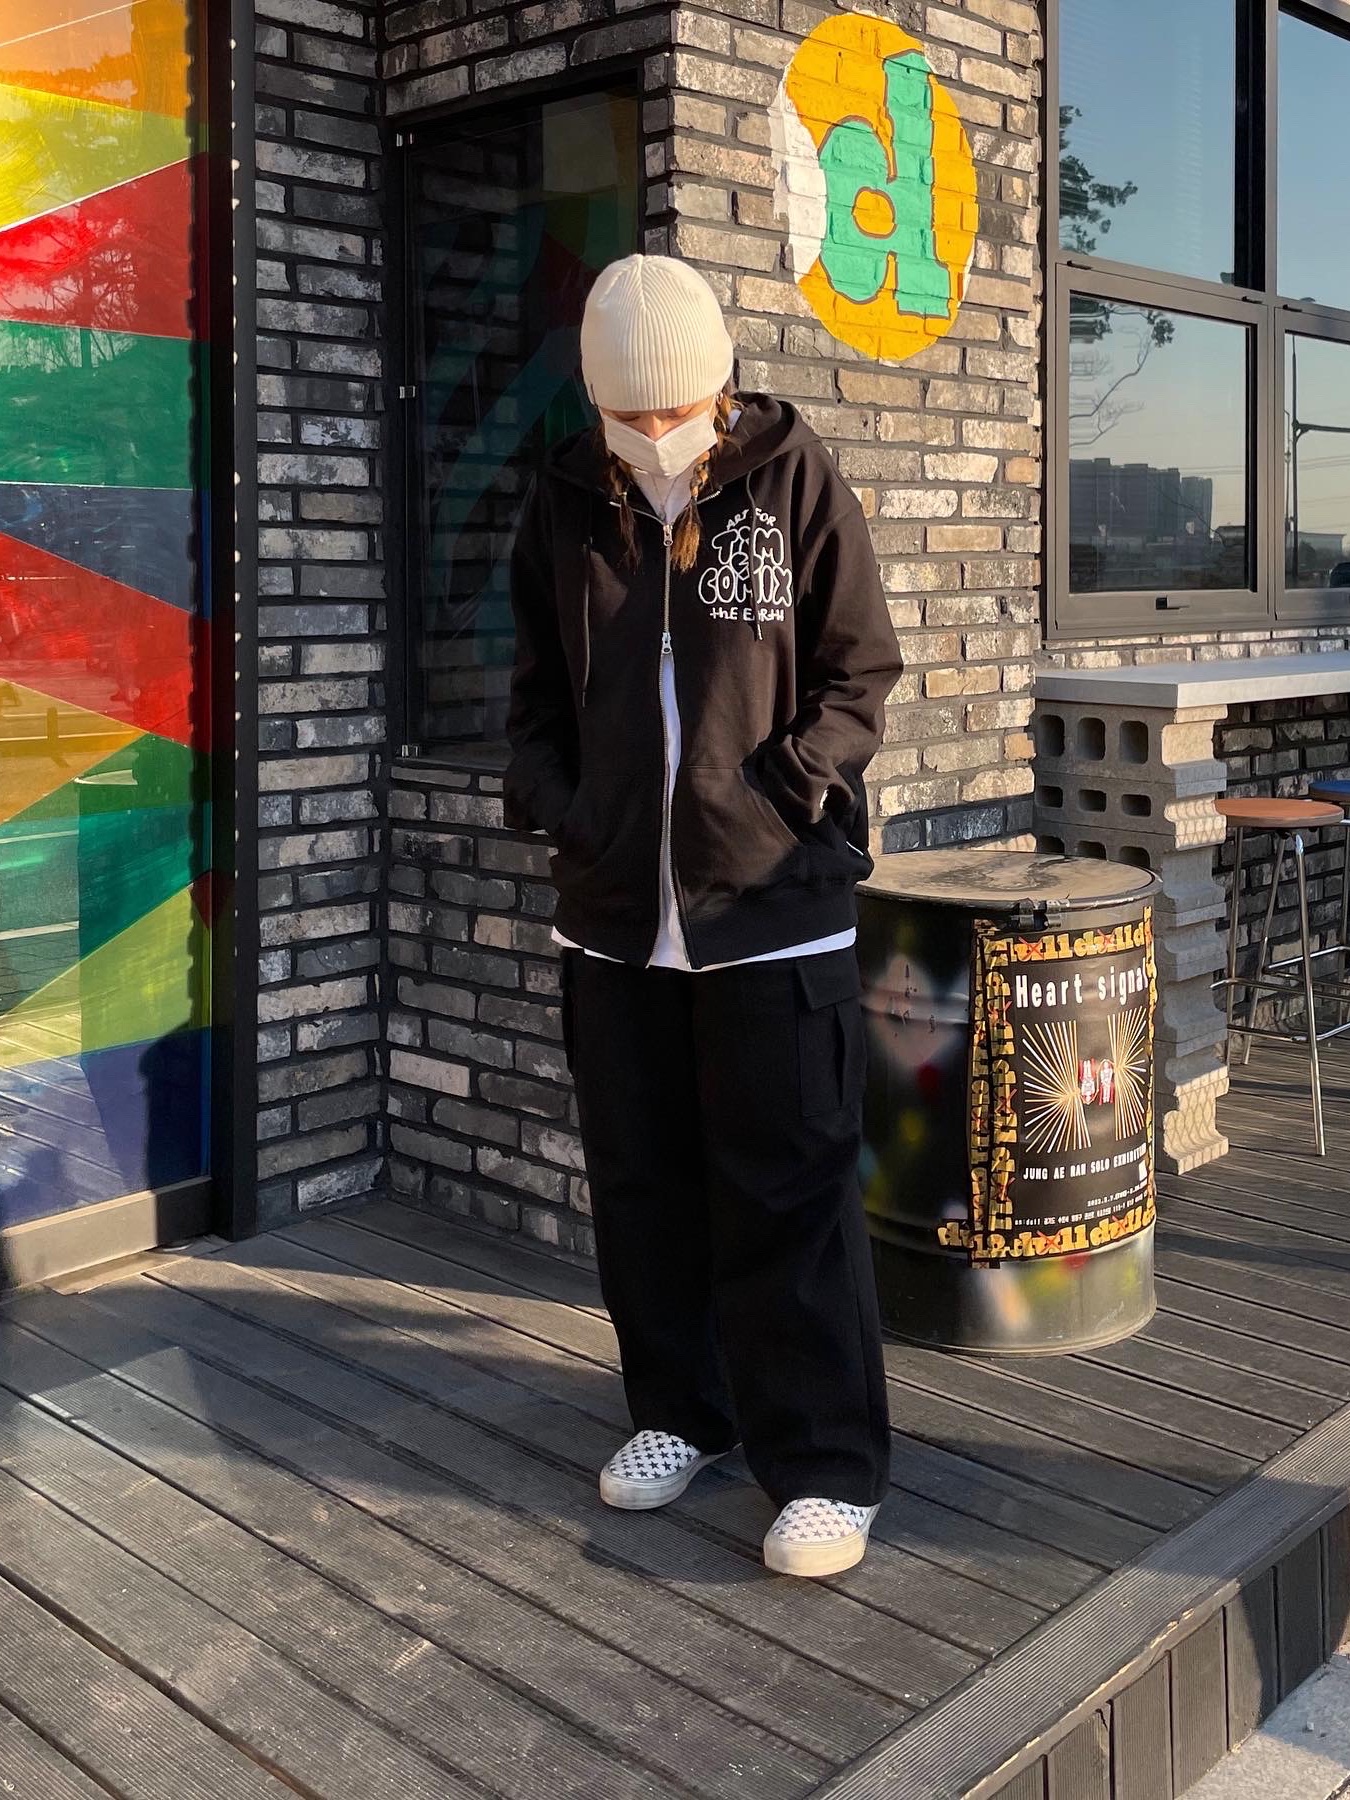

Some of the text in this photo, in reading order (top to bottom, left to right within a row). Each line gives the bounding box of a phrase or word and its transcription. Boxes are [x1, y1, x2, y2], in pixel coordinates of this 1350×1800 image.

[1015, 957, 1148, 1008] Heart signal
[1023, 1167, 1048, 1180] JUNG
[1053, 1166, 1065, 1180] AE
[1090, 1158, 1110, 1174] SOLO
